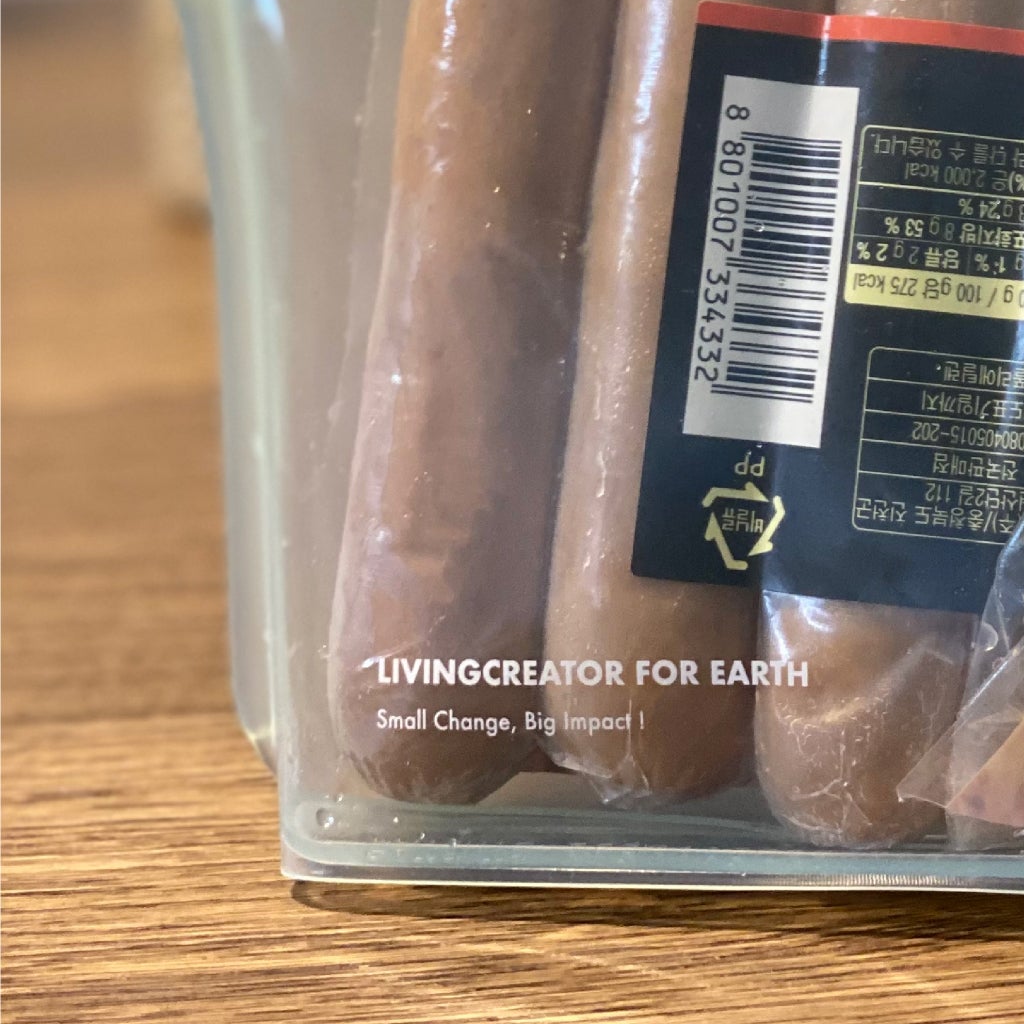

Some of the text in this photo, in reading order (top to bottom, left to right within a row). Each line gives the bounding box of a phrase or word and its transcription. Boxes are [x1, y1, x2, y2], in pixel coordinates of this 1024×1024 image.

[904, 162, 939, 183] kcal
[958, 198, 974, 215] %
[884, 216, 900, 235] %
[905, 218, 924, 238] 53
[693, 103, 751, 384] 8 801007 334332
[856, 241, 870, 260] %
[876, 243, 889, 262] 2
[892, 240, 904, 259] g
[924, 247, 960, 269] 당류
[974, 253, 990, 272] %
[853, 272, 885, 293] kcal
[890, 276, 918, 297] 275
[956, 282, 981, 303] 100
[1003, 285, 1014, 303] g
[733, 452, 765, 478] PP
[932, 451, 1018, 481] 전국판매점
[924, 482, 951, 503] 112
[721, 506, 765, 534] 비닐류
[854, 497, 907, 523] 진천군
[376, 658, 810, 688] LIVINGCREATOR FOR EARTH
[375, 708, 427, 730] Small
[433, 709, 518, 737] Change,
[524, 711, 556, 737] Big
[564, 711, 632, 737] Impact
